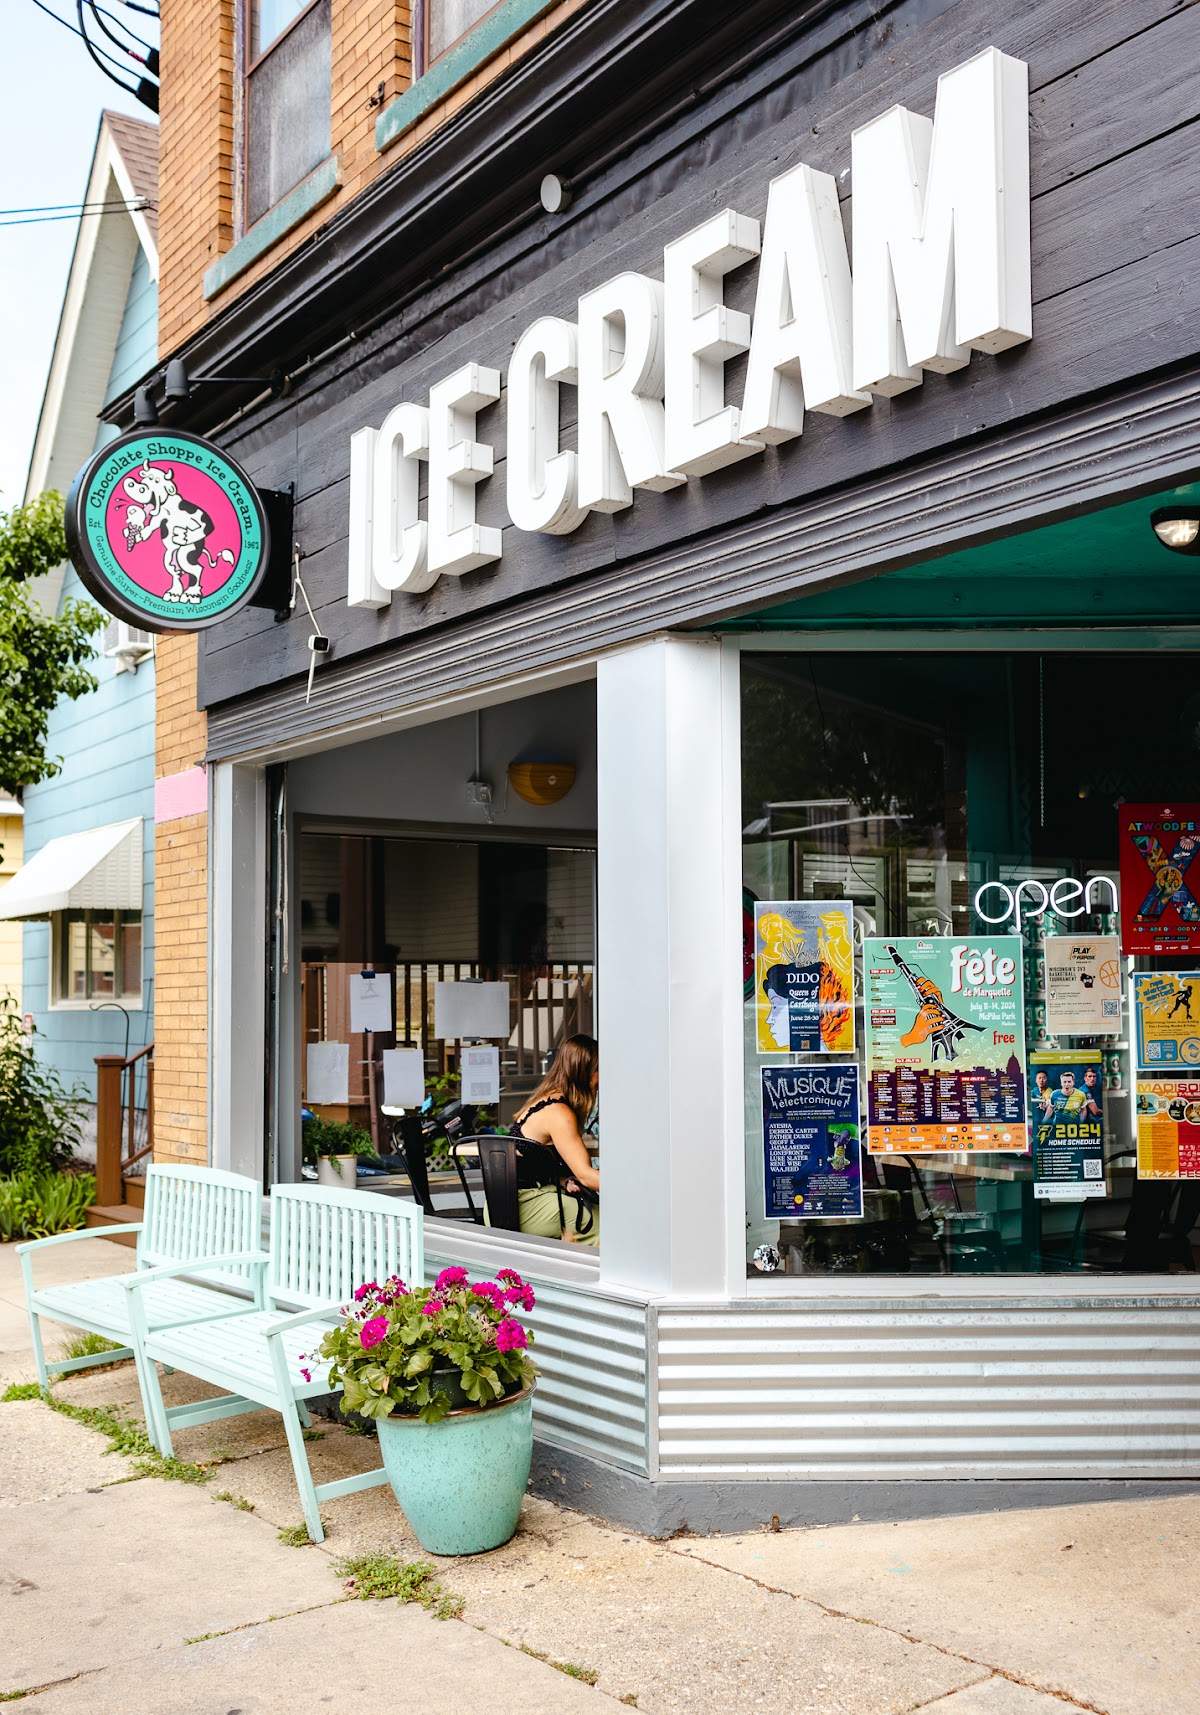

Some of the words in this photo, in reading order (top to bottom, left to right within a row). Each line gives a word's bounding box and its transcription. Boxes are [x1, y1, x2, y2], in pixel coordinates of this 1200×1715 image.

[348, 362, 501, 608] ICE
[507, 46, 1032, 535] CREAM
[90, 450, 143, 509] Chocolate
[147, 442, 202, 464] Shoppe
[206, 459, 226, 481] Ice
[228, 480, 253, 530] Cream
[88, 518, 103, 528] Est.
[96, 535, 116, 576] Genuine
[186, 593, 229, 614] Wisconsin
[227, 560, 253, 595] Goodness
[975, 876, 1118, 931] open
[786, 973, 820, 984] DIDO
[789, 989, 809, 1000] Queen
[811, 986, 819, 999] of
[963, 987, 973, 997] de
[973, 986, 1012, 1000] Marquette
[790, 998, 818, 1012] Carthage
[970, 1002, 982, 1012] July
[1000, 1001, 1016, 1010] 2024
[979, 1012, 1001, 1020] McPike
[1001, 1012, 1016, 1020] Park
[993, 1031, 1015, 1046] free
[1137, 1083, 1200, 1094] MADISO
[779, 1096, 843, 1108] électronique
[1055, 1123, 1101, 1138] 2024
[1067, 1138, 1101, 1146] SCHEDULE
[1139, 1170, 1178, 1178] JAZZ
